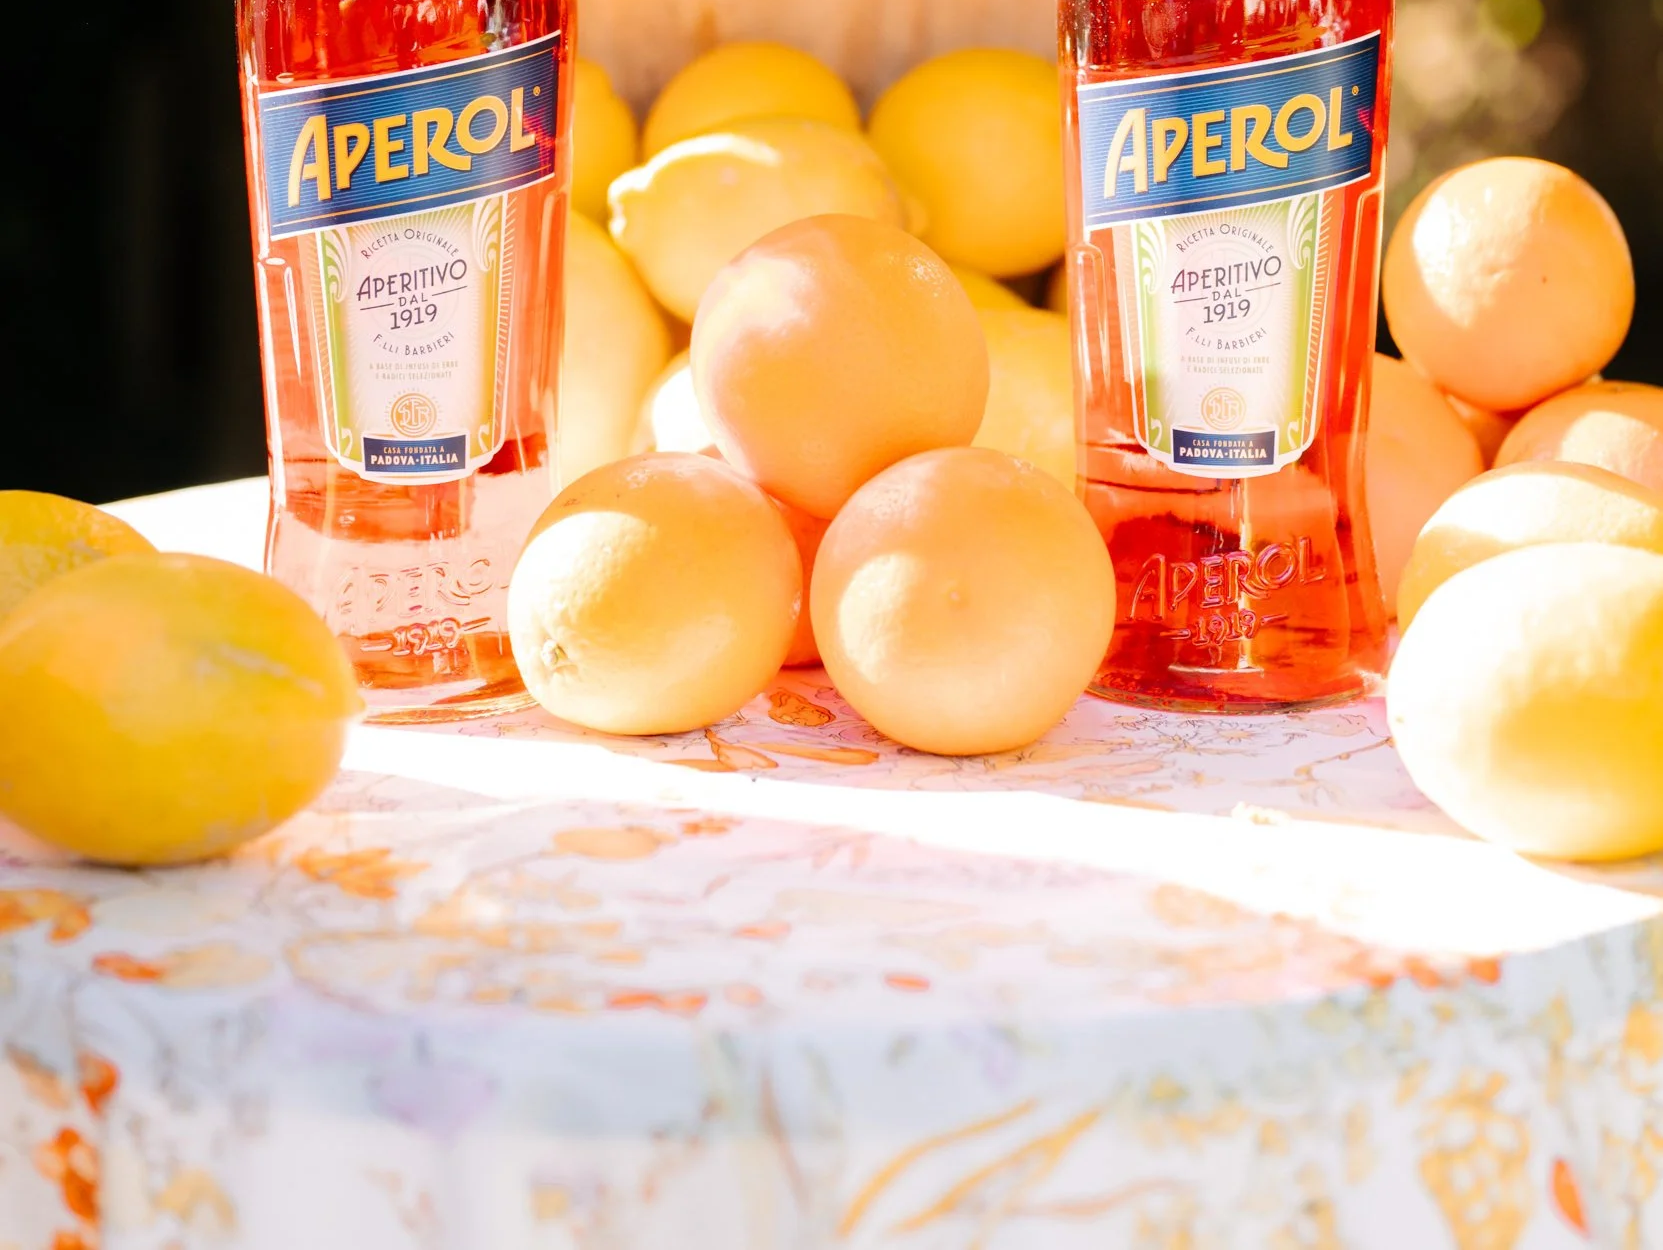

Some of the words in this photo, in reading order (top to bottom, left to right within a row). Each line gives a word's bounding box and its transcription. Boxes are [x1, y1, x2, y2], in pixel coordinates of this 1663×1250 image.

[288, 86, 535, 207] APEROL
[1103, 86, 1353, 199] APEROL
[361, 233, 399, 259] RICETTA
[404, 228, 459, 257] ORIGINALE
[1176, 226, 1215, 252] RICETTA
[1220, 224, 1274, 253] ORIGINALE
[356, 259, 467, 301] APERITIVO
[1171, 256, 1281, 294] APERITIVO
[398, 292, 428, 307] DAL
[1212, 288, 1242, 301] DAL
[390, 304, 438, 330] 1919
[1203, 299, 1250, 323] 1919
[405, 332, 455, 356] BARBIERI
[1217, 327, 1268, 350] BARBIERI
[383, 446, 401, 454] CASA
[404, 446, 437, 454] FONDATA
[1192, 439, 1210, 447] CASA
[1213, 440, 1246, 448] FONDATA
[1127, 535, 1327, 623] APEROL
